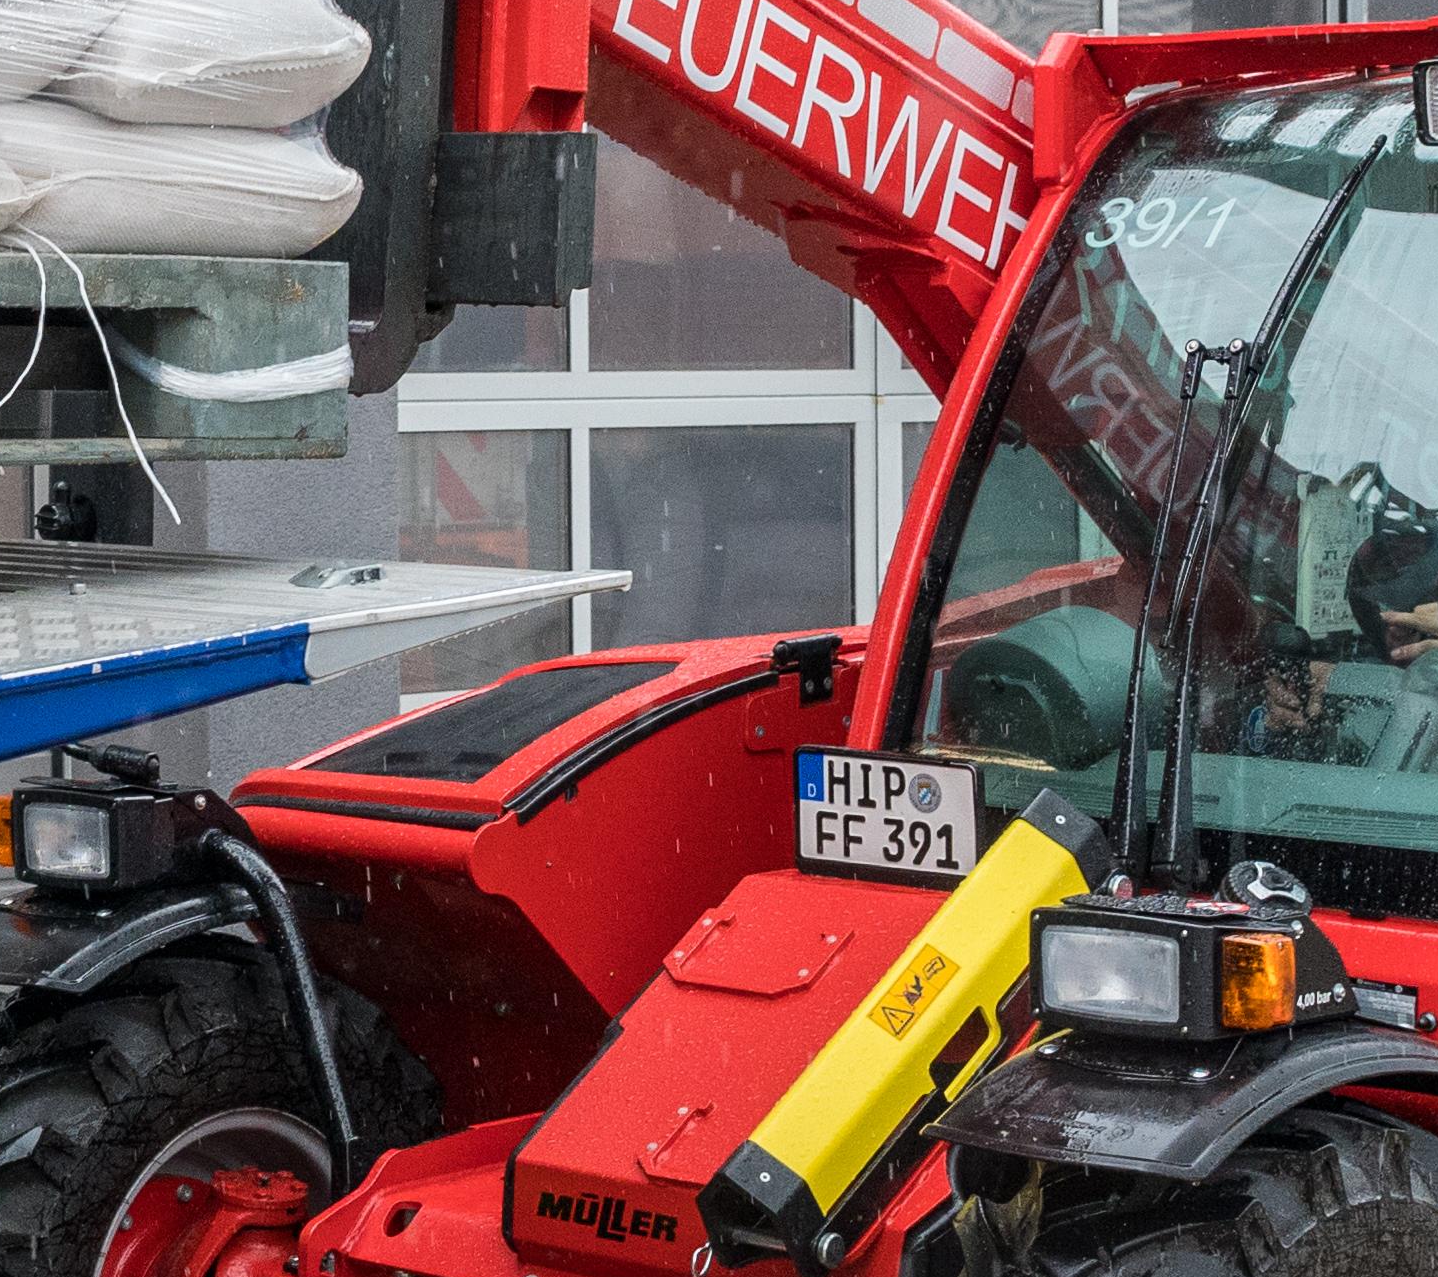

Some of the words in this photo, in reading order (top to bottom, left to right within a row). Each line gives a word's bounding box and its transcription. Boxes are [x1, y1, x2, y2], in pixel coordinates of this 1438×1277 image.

[1084, 196, 1237, 250] 39/1
[807, 783, 817, 798] D
[827, 760, 907, 811] HIP
[816, 810, 867, 858] FF
[882, 817, 960, 871] 391
[1296, 993, 1316, 1010] 4,00
[1317, 990, 1332, 1004] bar
[536, 1192, 680, 1243] MÜLLER
